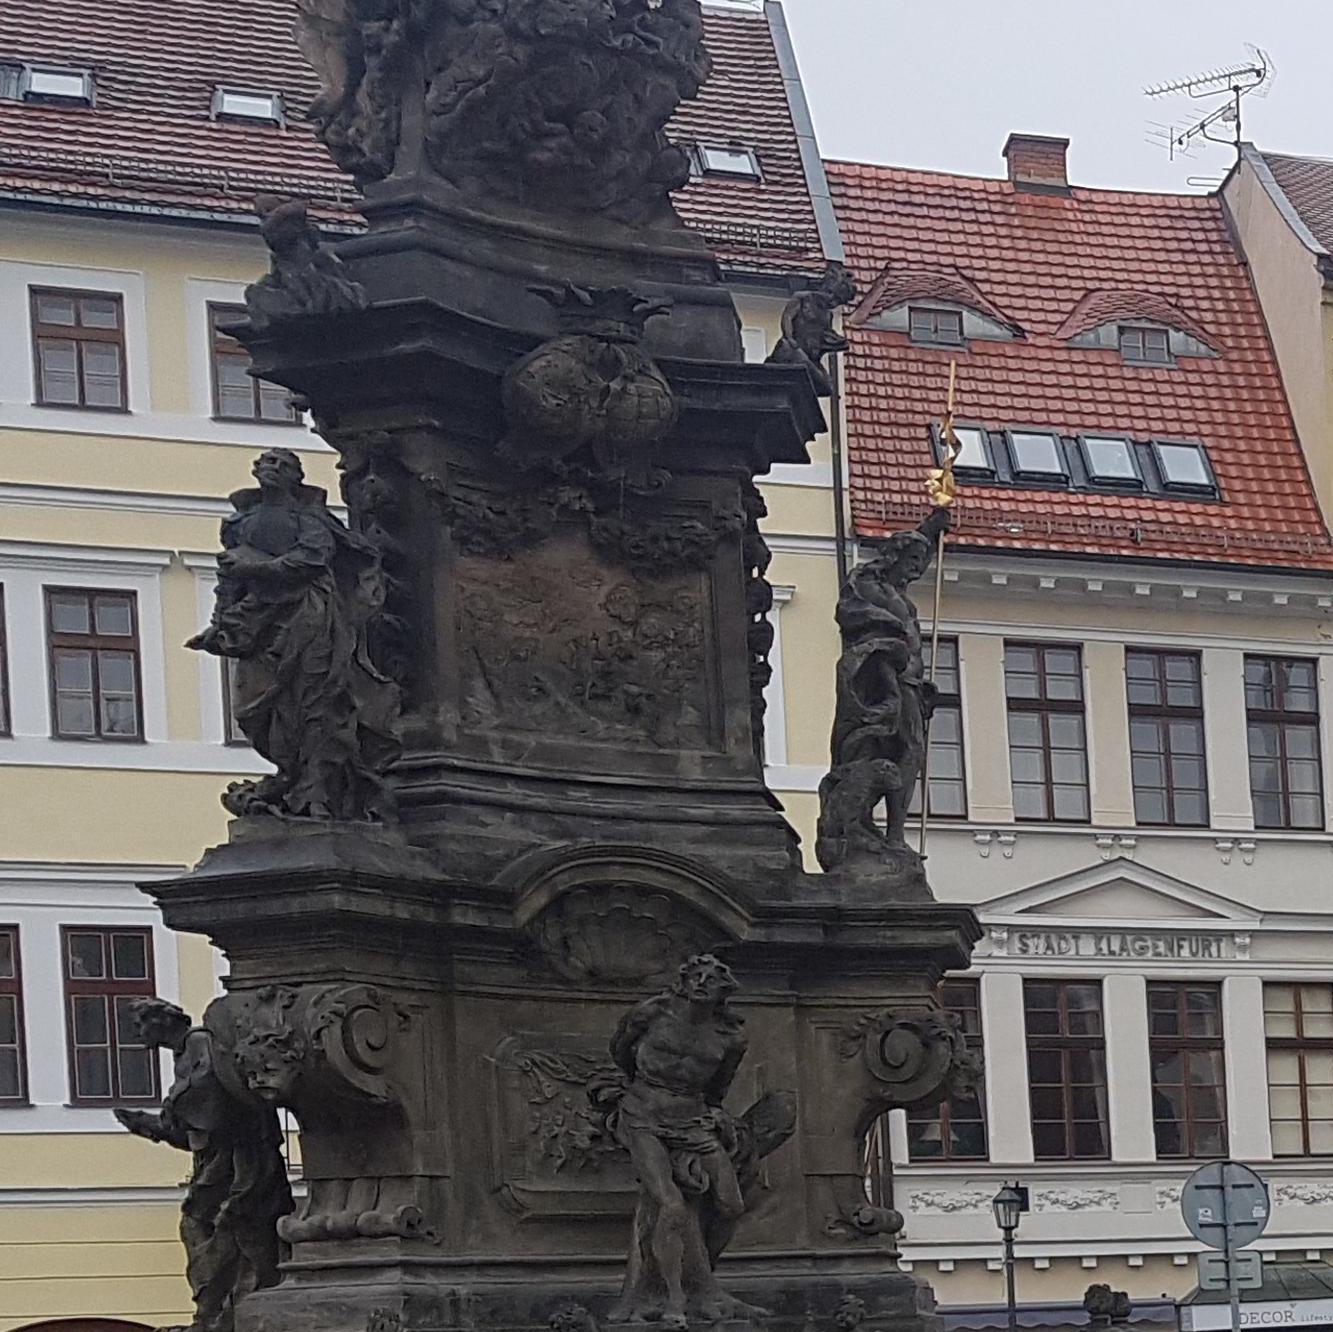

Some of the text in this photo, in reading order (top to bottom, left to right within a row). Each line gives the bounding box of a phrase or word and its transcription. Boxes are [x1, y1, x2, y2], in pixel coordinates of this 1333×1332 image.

[1017, 932, 1224, 958] STADT KLAGENFURT
[1239, 1310, 1295, 1325] DECOR
